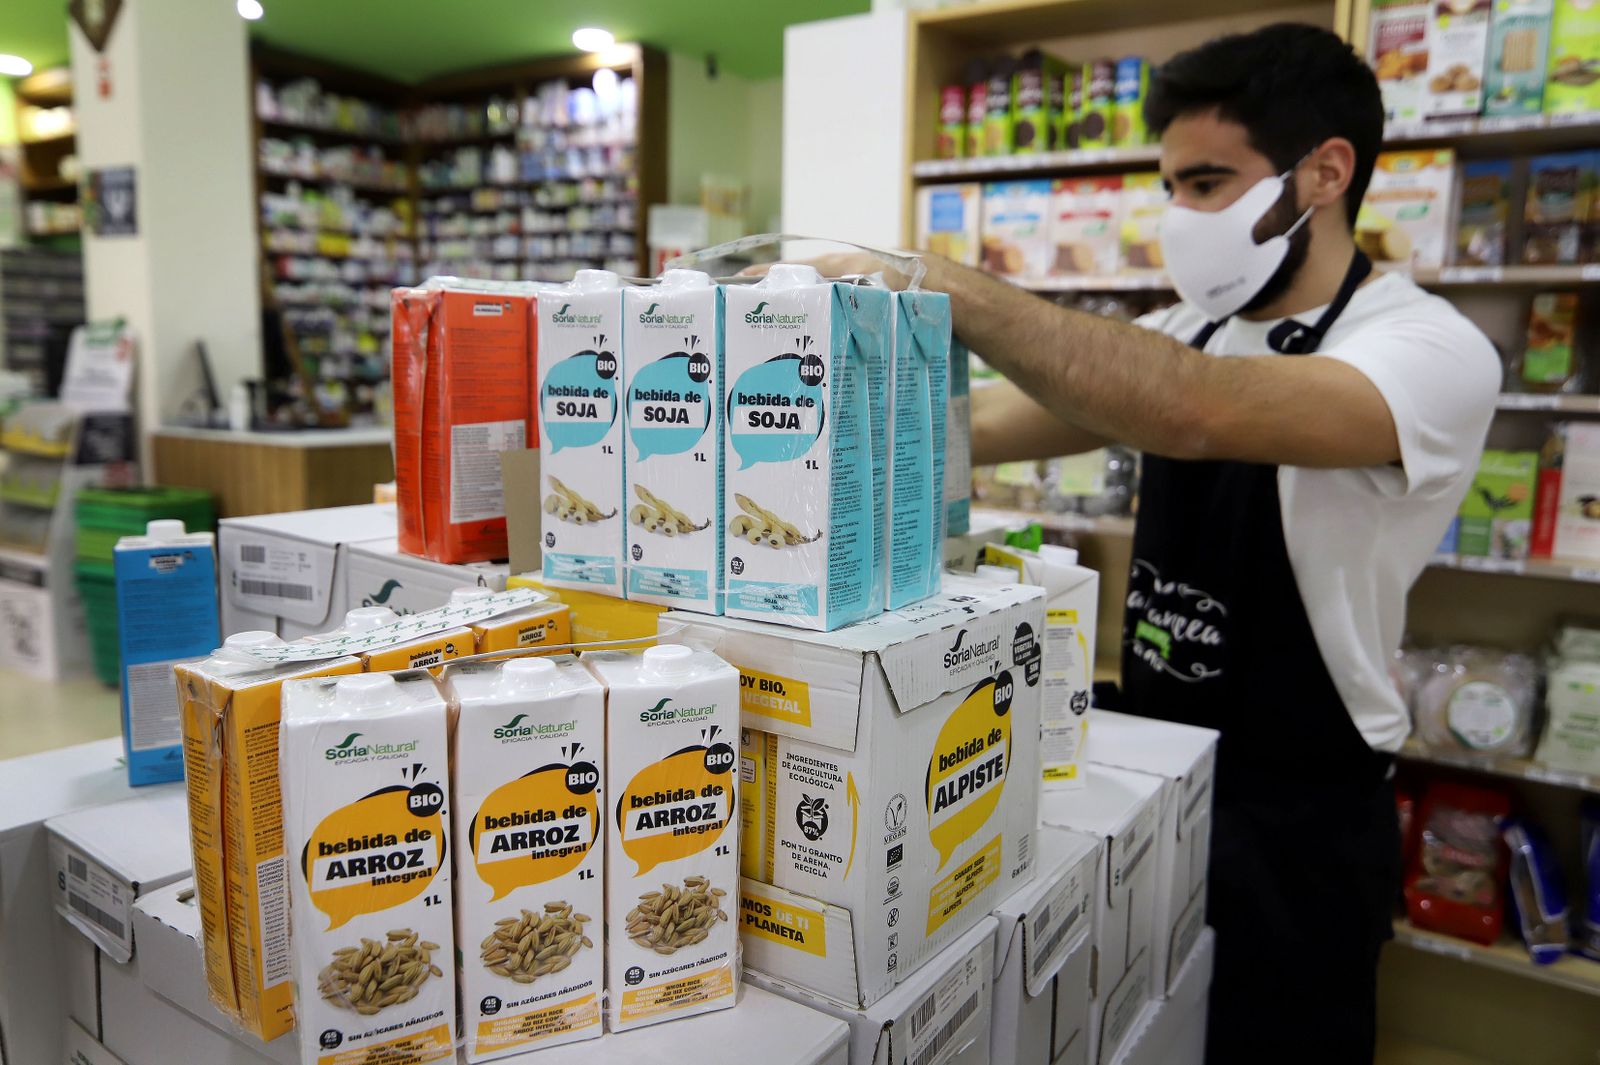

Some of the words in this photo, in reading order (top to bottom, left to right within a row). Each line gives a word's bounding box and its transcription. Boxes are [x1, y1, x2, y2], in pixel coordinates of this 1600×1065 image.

[639, 313, 692, 325] SoriaNatural
[745, 314, 806, 325] SoriaNatural
[597, 359, 616, 372] BIO
[689, 361, 710, 375] BIO
[801, 365, 822, 377] BIO
[548, 385, 589, 398] bebida
[593, 388, 609, 400] de
[635, 388, 678, 401] bebida
[684, 391, 702, 404] de
[737, 392, 791, 407] bebida
[795, 395, 815, 408] de
[556, 401, 598, 419] SOJA
[644, 406, 690, 425] SOJA
[748, 410, 801, 430] SOJA
[521, 632, 542, 642] ARROZ
[410, 652, 433, 661] bebida
[413, 656, 440, 668] ARROZ
[943, 640, 999, 669] SoriaNatural
[740, 675, 755, 688] OY
[743, 692, 802, 714] VEGETAL
[994, 682, 1013, 706] BIO
[640, 705, 715, 723] SoriaNatural
[647, 718, 675, 727] EFICACIA
[682, 715, 708, 724] CALIDAD
[493, 721, 575, 740] SoriaNatural
[502, 735, 532, 744] EFICACIA
[540, 731, 568, 740] CALIDAD
[325, 742, 416, 761] SoriaNatural
[335, 756, 368, 766] EFICACIA
[377, 752, 409, 762] CALIDAD
[939, 739, 984, 772] bebida
[988, 728, 1002, 747] de
[706, 753, 732, 767] BIO
[786, 752, 839, 772] INGREDIENTES
[568, 771, 597, 787] BIO
[782, 761, 792, 770] DE
[793, 764, 844, 784] AGRICULTURA
[789, 772, 835, 791] ECOLÓGICA
[934, 753, 1004, 815] ALPISTE
[410, 792, 441, 809] BIO
[631, 787, 695, 809] bebida
[700, 784, 724, 798] de
[485, 808, 556, 831] bebida
[562, 804, 588, 820] de
[636, 803, 717, 831] ARROZ
[673, 820, 723, 837] integral
[804, 824, 820, 838] 87%
[884, 828, 907, 844] VEGAN
[318, 832, 397, 857] bebida
[404, 828, 431, 844] de
[490, 824, 580, 854] ARROZ
[532, 843, 587, 861] integral
[781, 839, 797, 851] PON
[799, 843, 808, 853] TU
[809, 847, 843, 864] GRANITO
[791, 851, 802, 861] DE
[325, 848, 424, 881] ARROZ
[794, 863, 828, 879] RECICLA
[371, 867, 433, 887] integral
[746, 913, 805, 944] PLANETA
[649, 971, 662, 979] SIN
[661, 962, 695, 976] AZÚCARES
[696, 951, 728, 967] AÑADIDOS
[506, 1001, 519, 1009] SIN
[520, 991, 557, 1007] AZÚCARES
[558, 979, 593, 998] AÑADIDOS
[348, 1033, 361, 1042] SIN
[405, 1010, 444, 1026] AÑADIDOS
